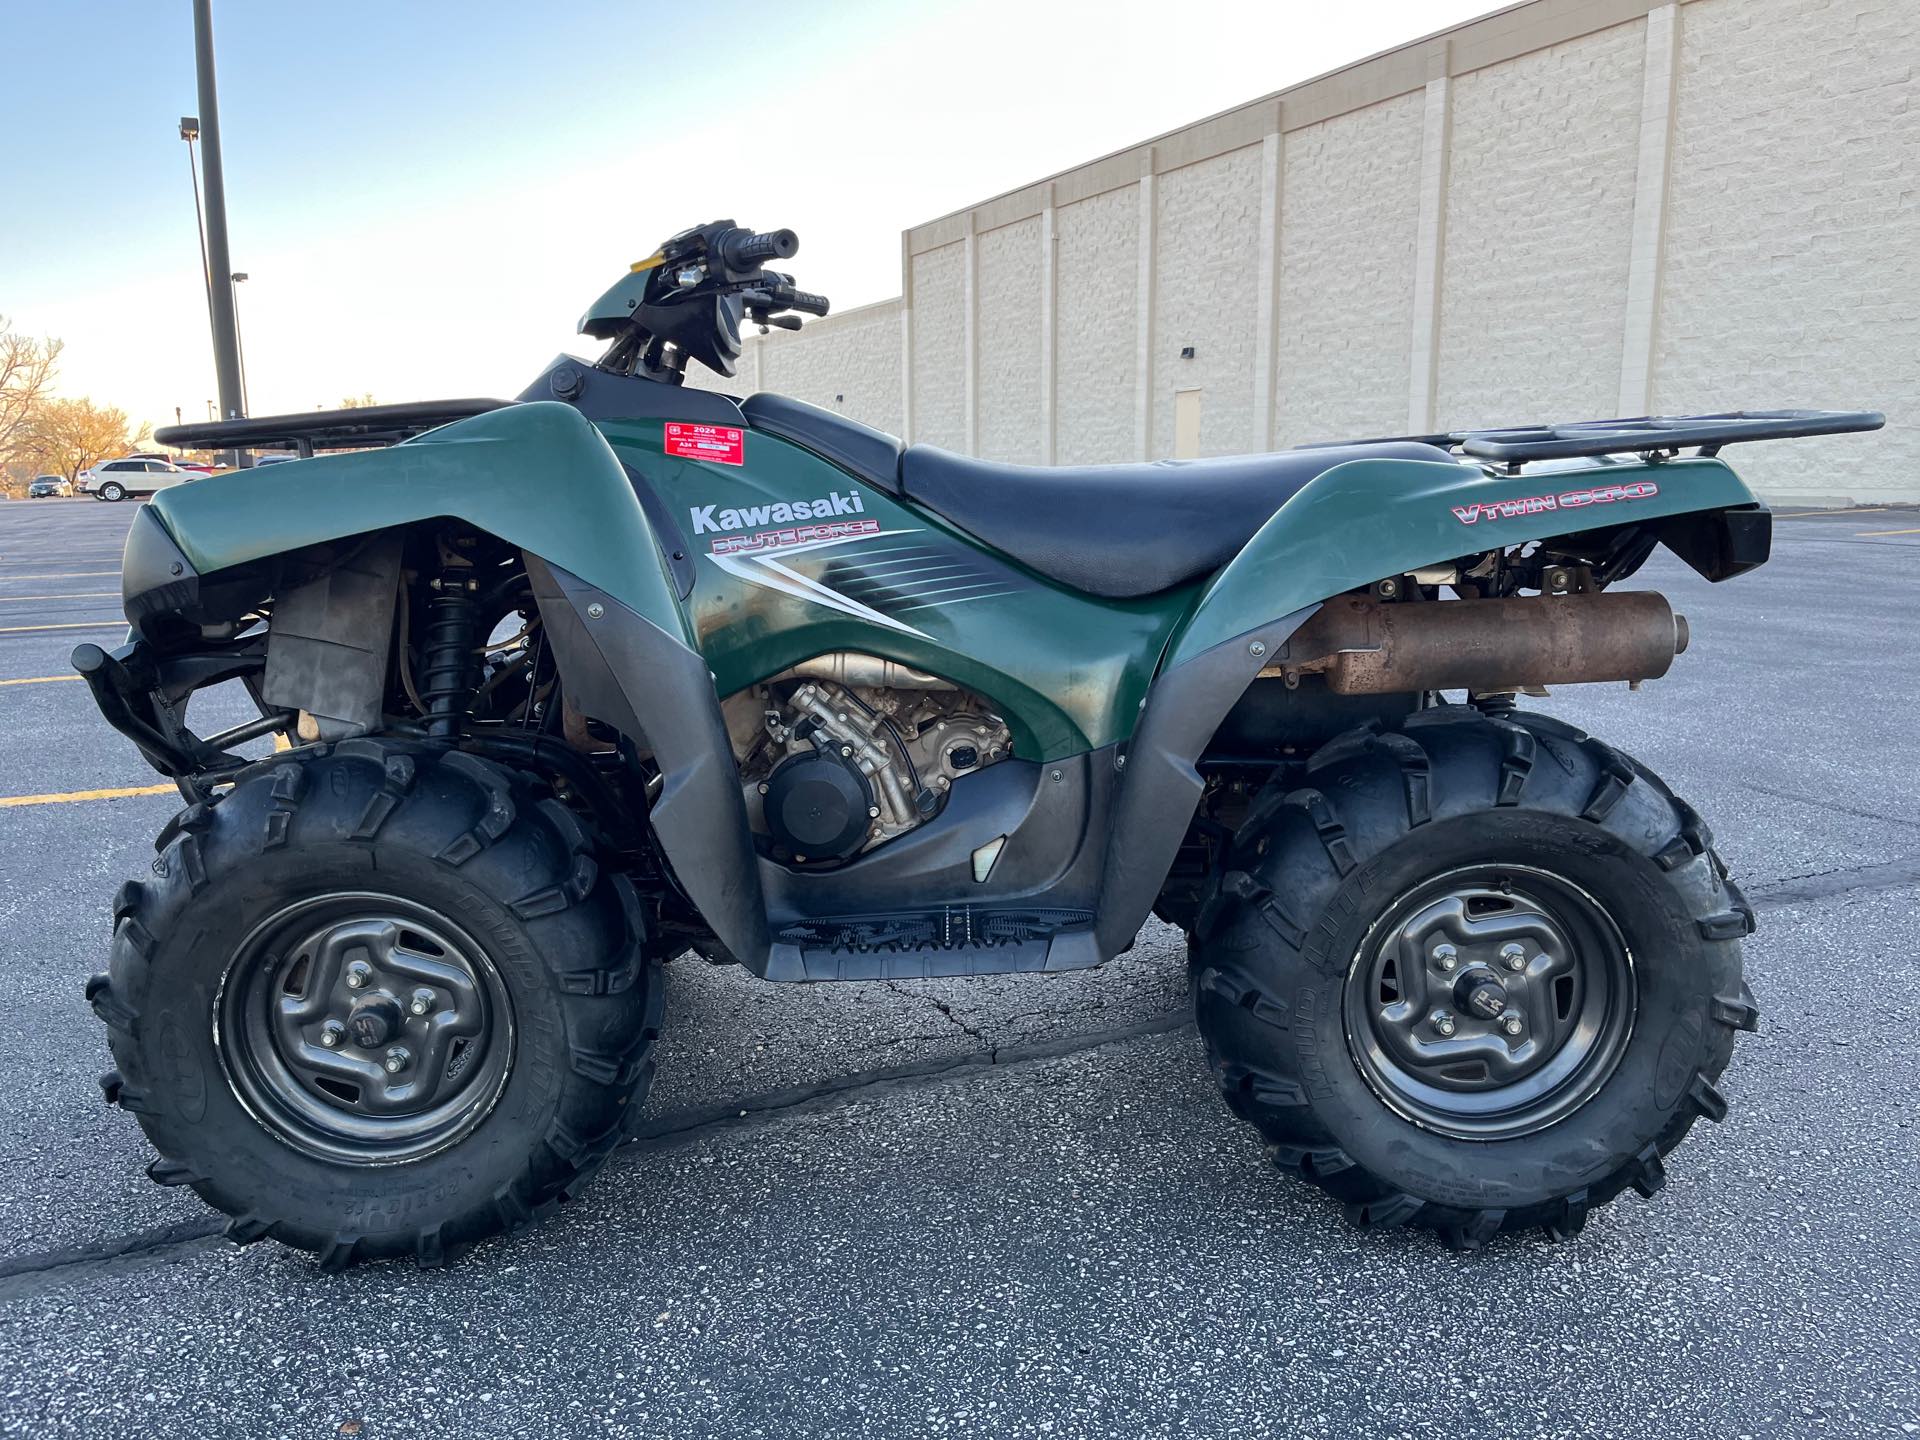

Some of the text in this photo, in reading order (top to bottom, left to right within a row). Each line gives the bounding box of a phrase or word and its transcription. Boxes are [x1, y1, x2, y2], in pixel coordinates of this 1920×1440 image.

[694, 427, 716, 435] 2024
[1558, 482, 1659, 508] 650
[690, 490, 865, 535] Kawasaki
[712, 520, 880, 554] BRUTE FORCE
